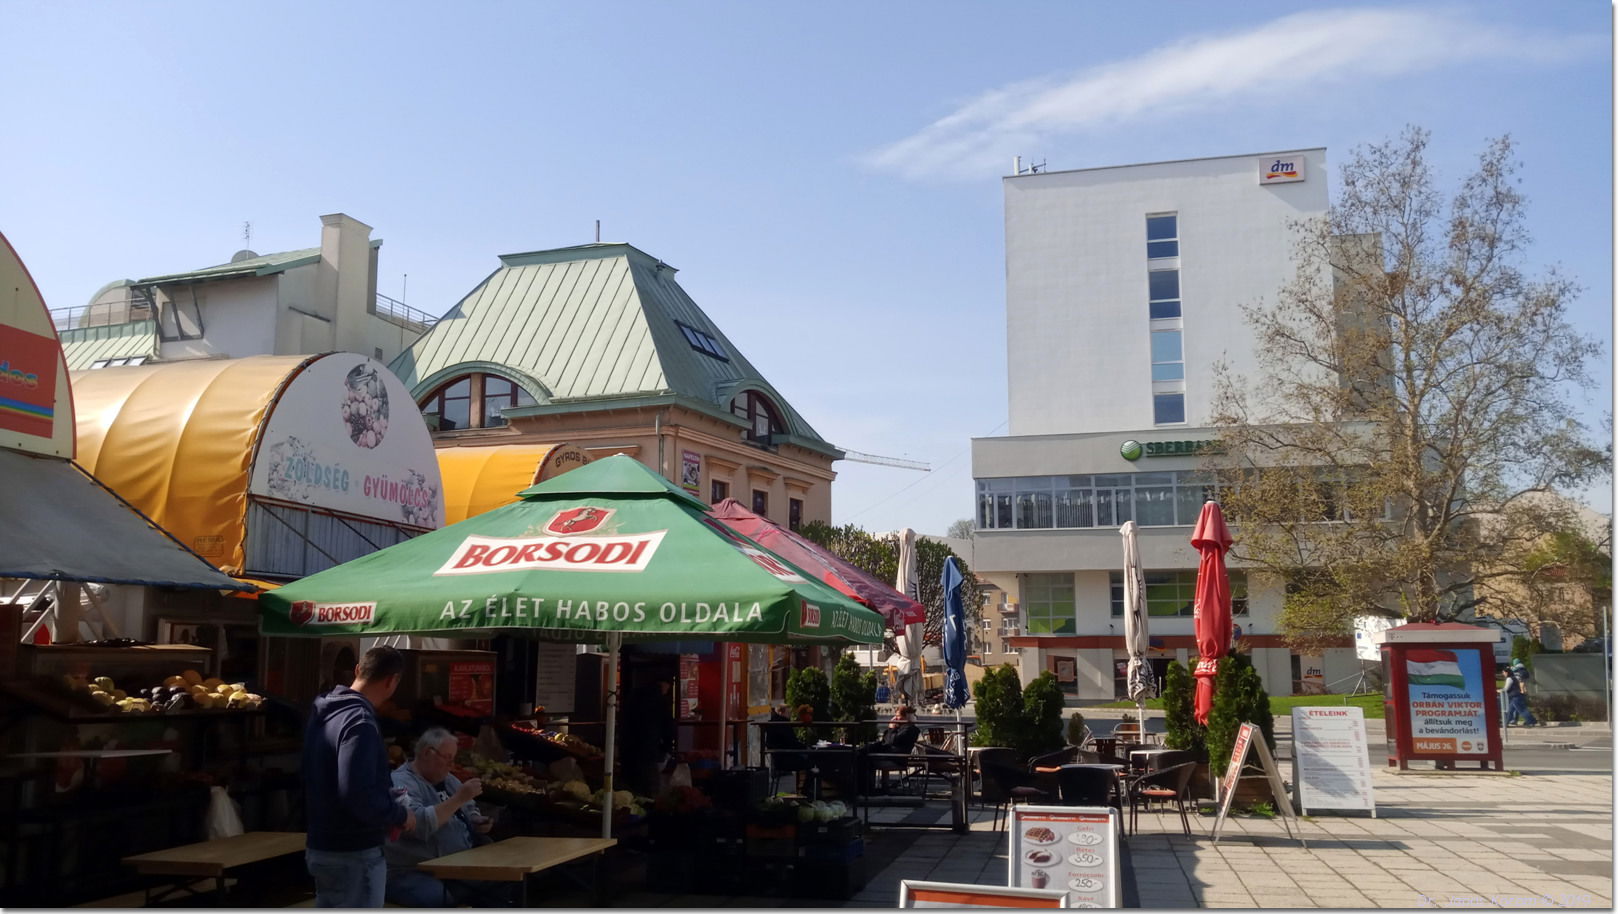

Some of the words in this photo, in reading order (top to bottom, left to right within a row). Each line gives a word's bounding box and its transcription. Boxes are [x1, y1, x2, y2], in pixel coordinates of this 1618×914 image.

[1271, 160, 1294, 172] dm
[555, 451, 580, 468] GYROS
[453, 540, 651, 569] BORSODI
[439, 599, 474, 620] AZ
[485, 594, 545, 620] ÉLET
[556, 599, 646, 623] HABOS
[659, 602, 764, 623] OLDALA
[317, 605, 373, 622] BORSODI
[1306, 666, 1321, 675] dm
[1422, 692, 1471, 701] Támogassuk
[1412, 701, 1444, 709] ORBÁN
[1424, 718, 1452, 726] állítsuk
[1425, 727, 1480, 735] bevándorlást!
[1416, 741, 1441, 750] MÁJUS
